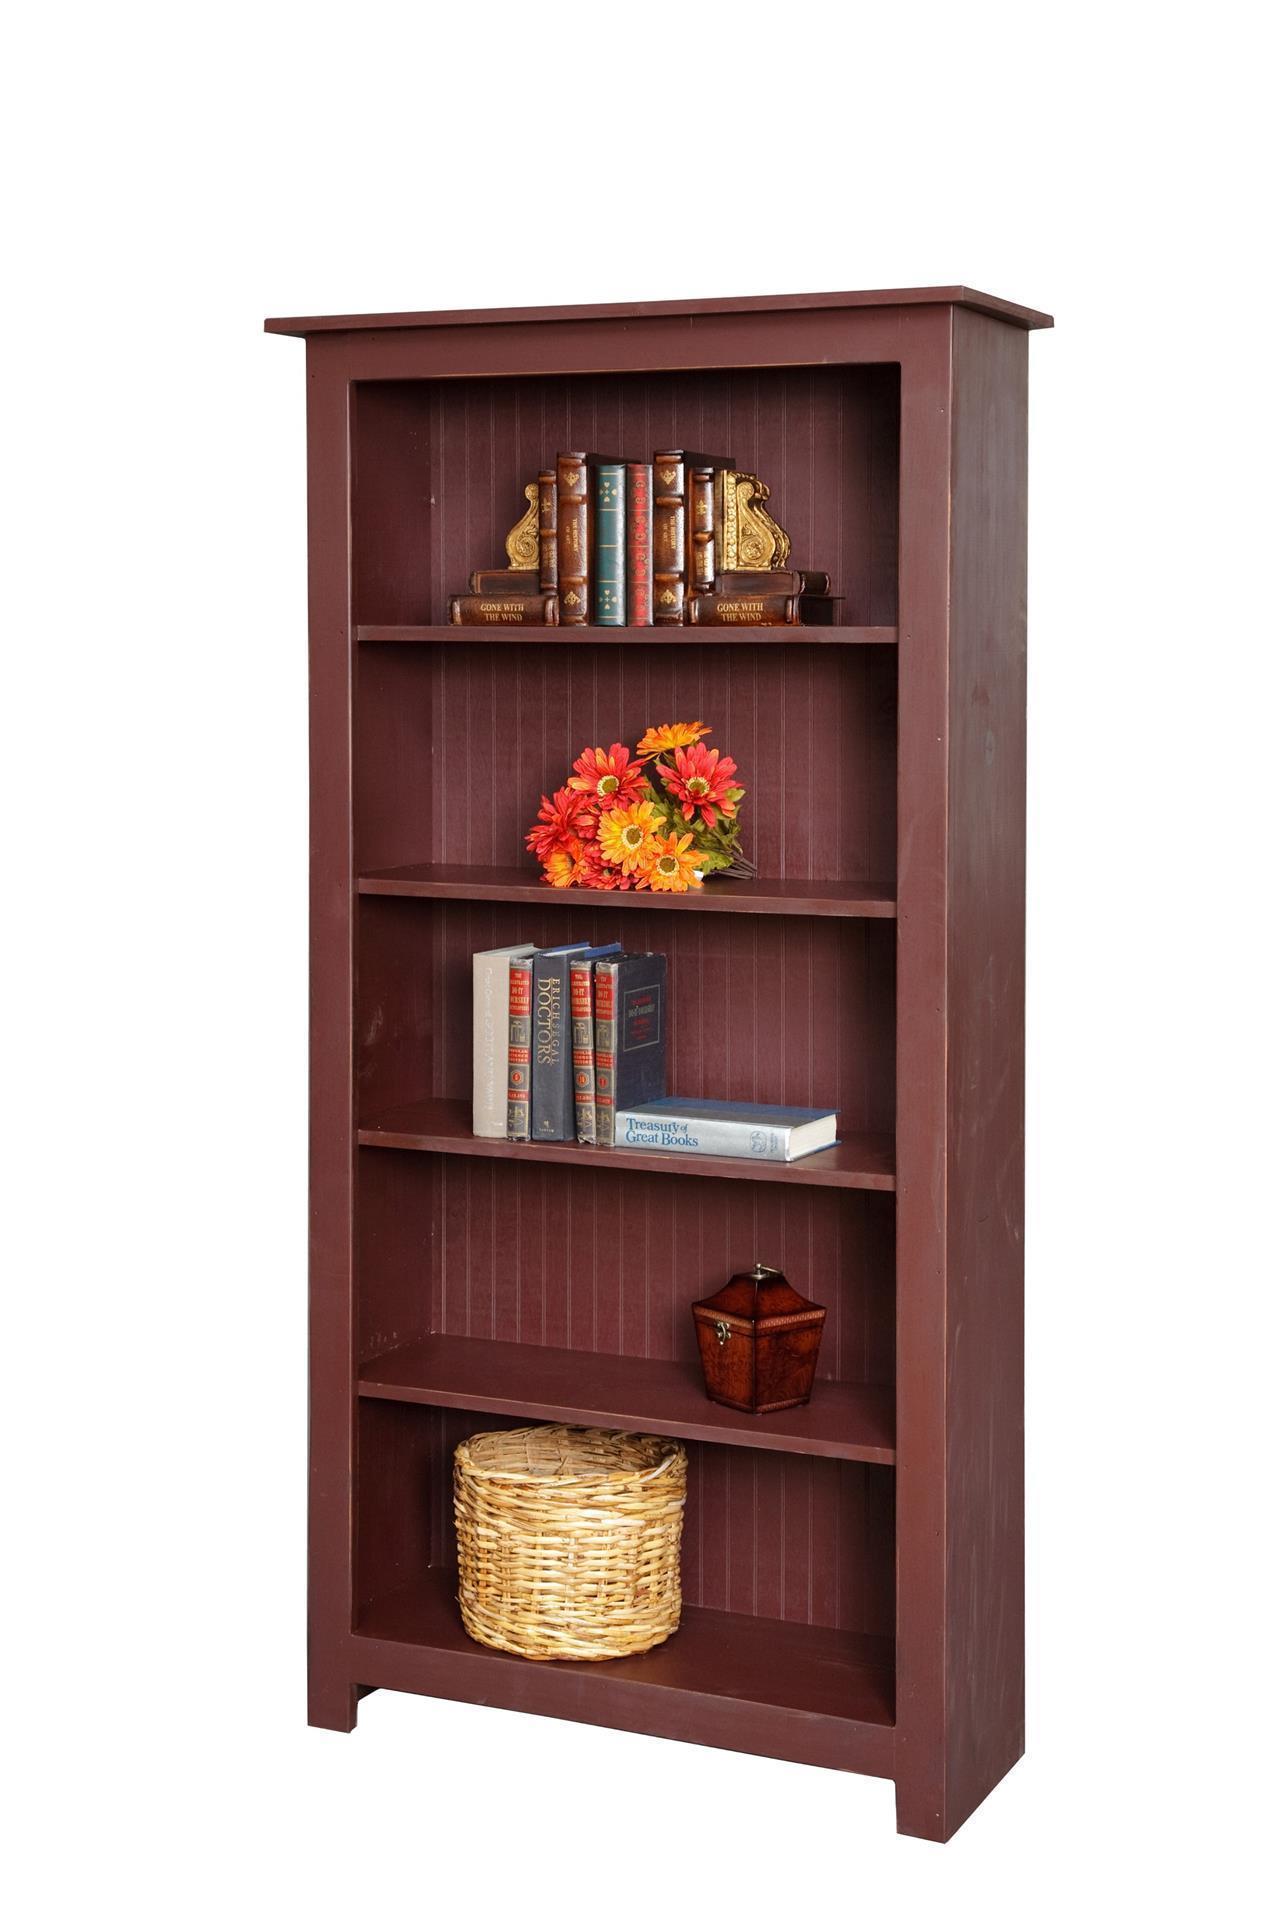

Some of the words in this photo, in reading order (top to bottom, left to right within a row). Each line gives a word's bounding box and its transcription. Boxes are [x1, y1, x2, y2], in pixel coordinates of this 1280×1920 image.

[480, 603, 501, 612] GONE
[503, 603, 524, 612] WITH
[717, 603, 739, 612] GONE
[740, 602, 763, 612] WITH
[484, 613, 500, 621] THE
[501, 613, 523, 621] WIND
[721, 613, 737, 622] THE
[739, 612, 762, 621] WIND
[552, 978, 561, 1020] ERICH
[537, 978, 551, 1065] DOCTORS
[551, 1023, 560, 1064] SEGAL
[626, 1118, 679, 1135] Treasury
[680, 1124, 688, 1133] of
[626, 1130, 659, 1143] Great
[661, 1132, 698, 1146] Books
